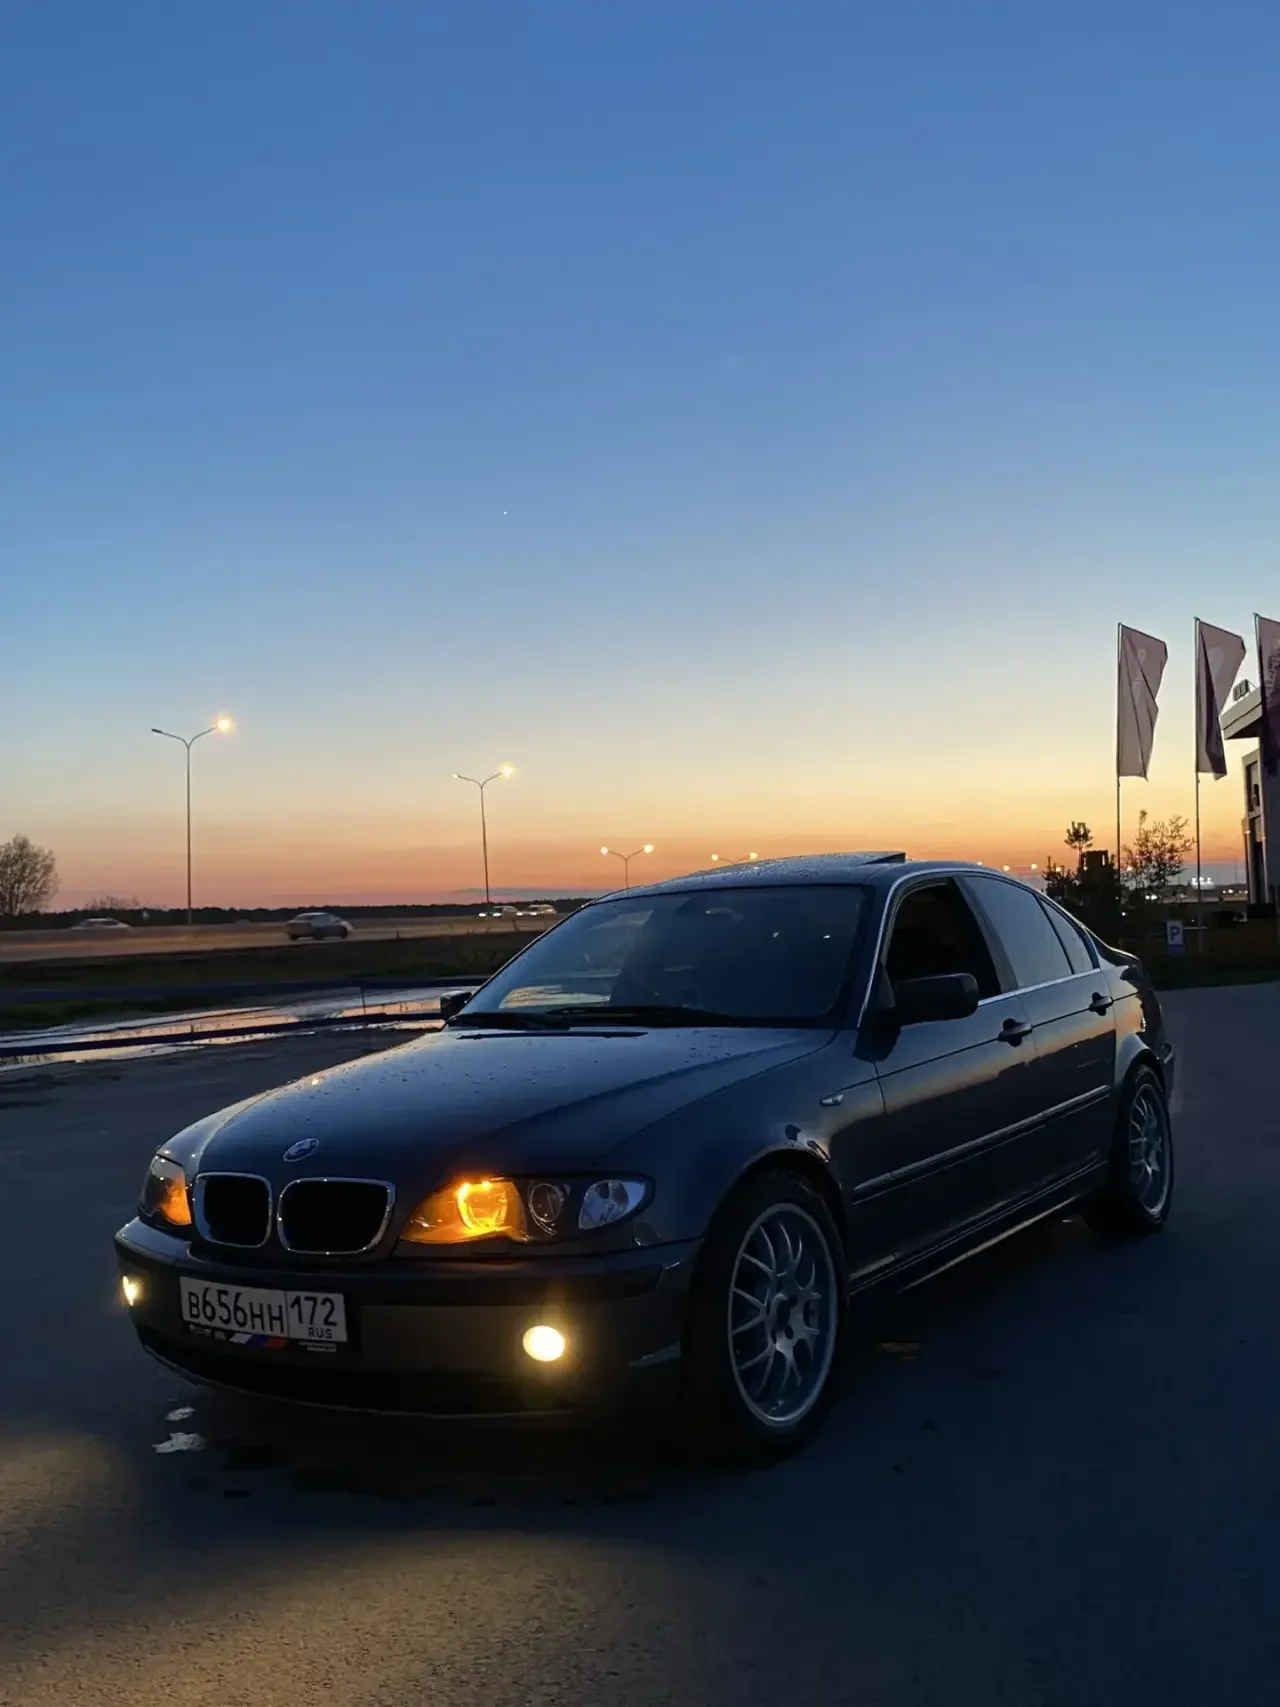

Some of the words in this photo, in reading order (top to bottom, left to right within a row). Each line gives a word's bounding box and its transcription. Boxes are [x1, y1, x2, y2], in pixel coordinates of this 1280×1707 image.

[1169, 926, 1181, 942] P
[290, 1295, 338, 1326] 172
[308, 1327, 333, 1339] RUS
